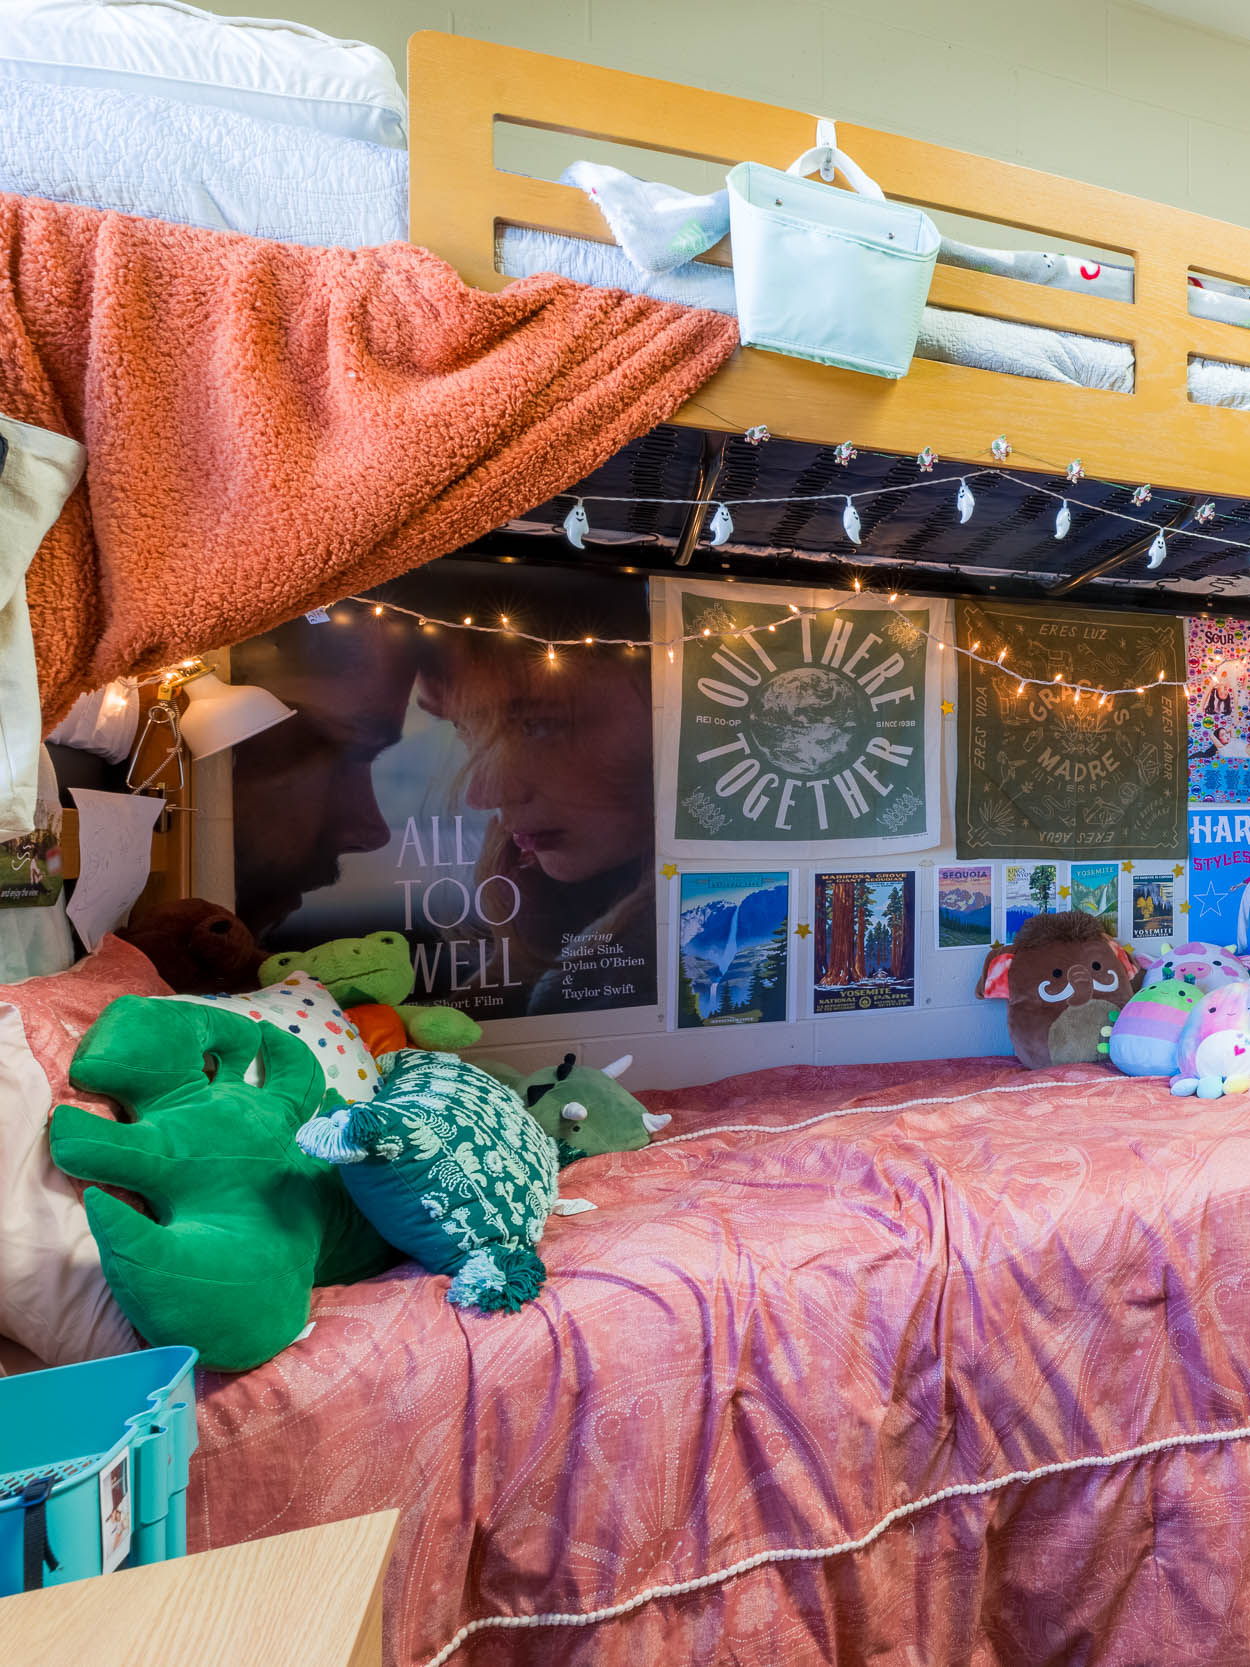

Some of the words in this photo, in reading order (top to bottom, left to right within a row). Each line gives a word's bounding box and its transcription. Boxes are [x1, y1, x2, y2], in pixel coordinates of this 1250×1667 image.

[1039, 623, 1077, 638] ERES
[1083, 627, 1111, 641] LUZ
[1204, 630, 1235, 645] SOUR
[697, 624, 777, 708] OUT
[801, 613, 916, 713] THERE
[975, 686, 989, 724] VIDA
[1029, 679, 1130, 725] GRACIAS
[696, 715, 712, 725] REI
[714, 717, 742, 727] CO-OP
[1161, 695, 1173, 737] ERES
[876, 720, 897, 728] SINCE
[898, 720, 916, 728] 1938
[974, 726, 988, 770] ERES
[1037, 747, 1121, 782] MADRE
[1161, 740, 1174, 781] AMOR
[696, 732, 914, 831] TOGETHER
[393, 815, 477, 869] ALL
[1039, 831, 1073, 843] AGUA
[1076, 831, 1115, 843] ERES
[942, 871, 987, 879] SEQUOIA
[1076, 866, 1114, 877] YOSEMITE
[394, 875, 521, 931] TOO
[561, 931, 613, 945] Starring
[1133, 927, 1173, 935] YOSEMITE
[561, 947, 594, 958] Sadie
[596, 943, 624, 955] Sink
[410, 937, 523, 995] WELL
[561, 959, 598, 974] Dylan
[600, 956, 645, 969] O'Brien
[562, 974, 574, 985] &
[561, 988, 601, 1000] Taylor
[602, 984, 636, 996] Swift
[840, 987, 892, 997] YOSEMITE
[873, 992, 909, 1000] PARK
[433, 997, 471, 1010] Short
[473, 995, 504, 1007] Film
